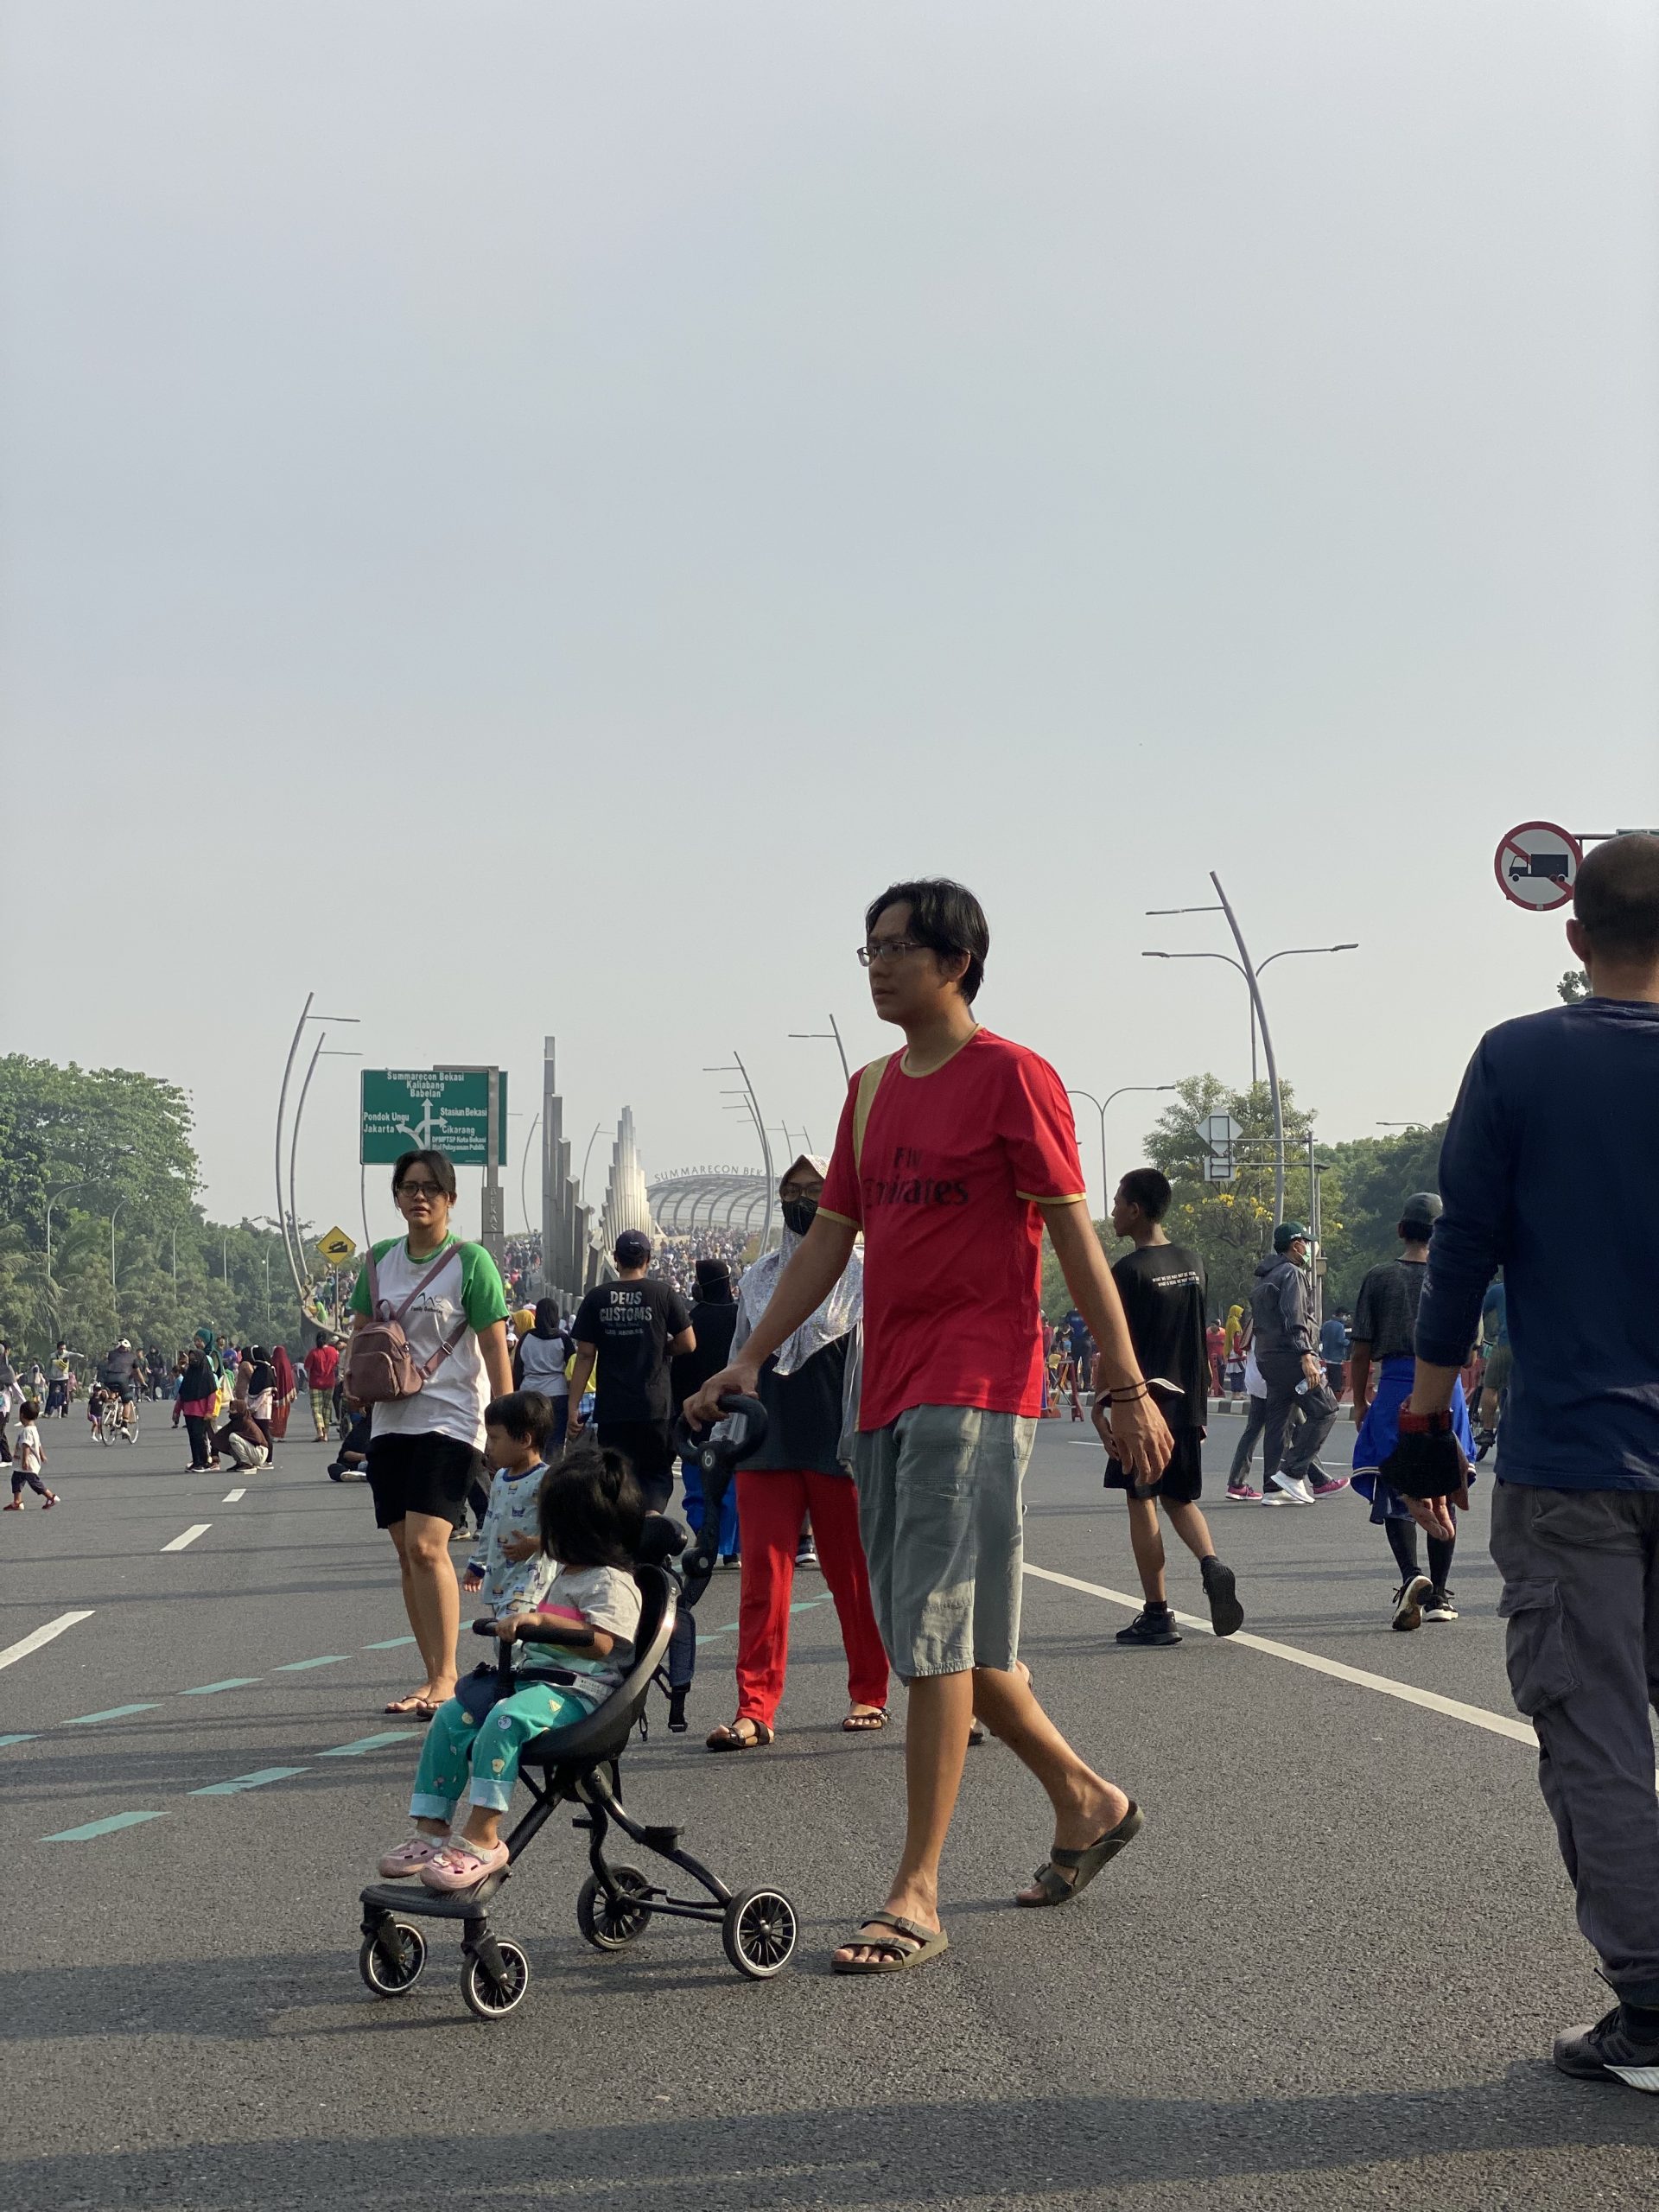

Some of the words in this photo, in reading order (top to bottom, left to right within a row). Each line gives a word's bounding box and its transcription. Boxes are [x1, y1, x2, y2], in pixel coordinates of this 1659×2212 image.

[387, 1071, 437, 1080] Summarecon
[439, 1071, 465, 1081] Bekasi
[406, 1080, 445, 1091] Kaliabang
[410, 1089, 442, 1097] Babelan
[364, 1112, 390, 1121] Pondok
[391, 1112, 410, 1122] Ungu
[440, 1107, 464, 1116] Stasiun
[465, 1108, 487, 1116] Bekasi
[363, 1124, 395, 1133] Jakarta
[442, 1125, 475, 1136] Cikarang
[654, 1165, 739, 1182] SUMMARECON
[489, 1187, 498, 1242] BEKASI
[610, 1290, 643, 1305] DEUS
[600, 1306, 652, 1322] CUSTOMS
